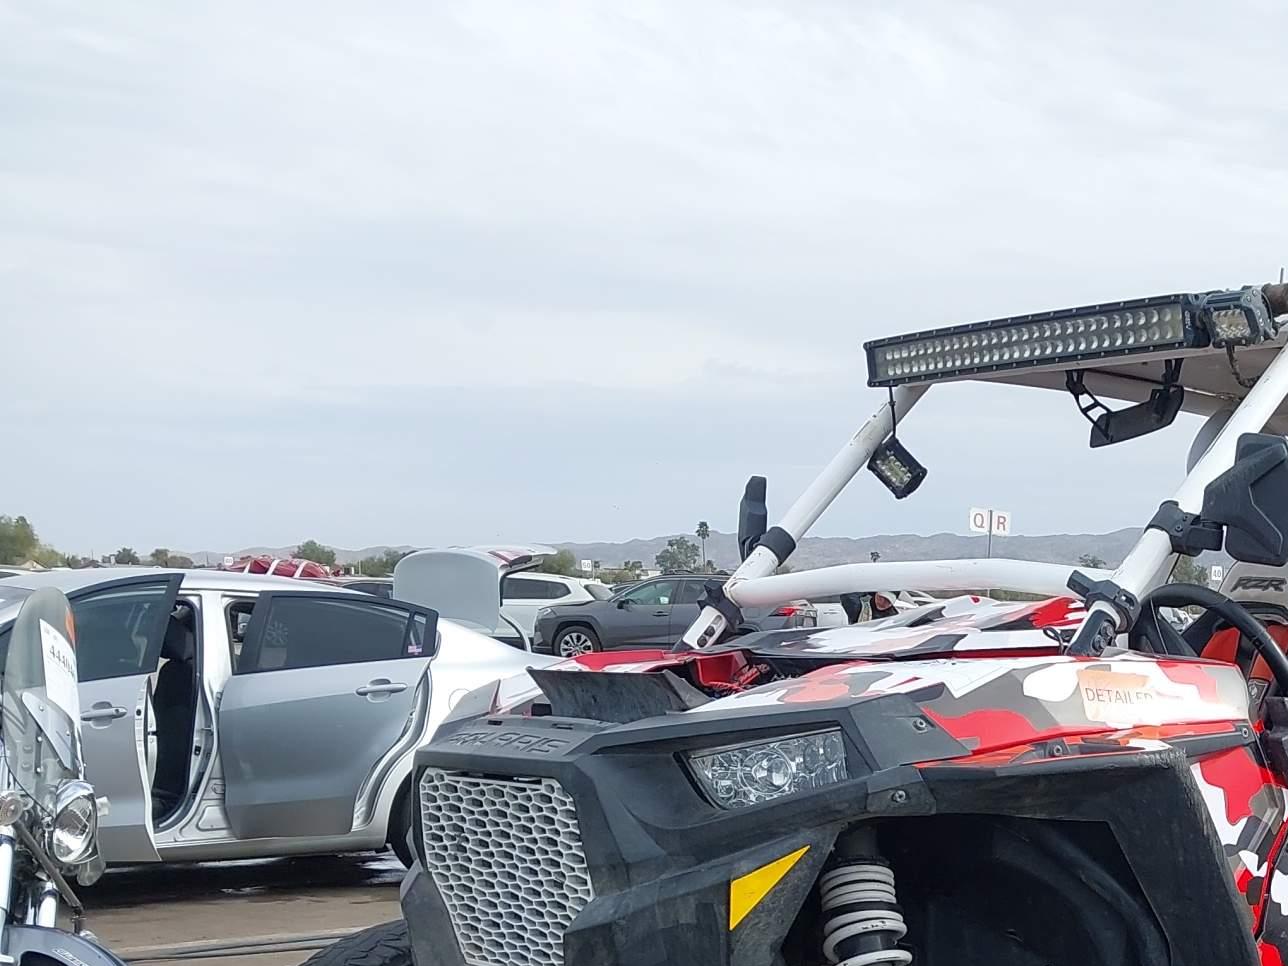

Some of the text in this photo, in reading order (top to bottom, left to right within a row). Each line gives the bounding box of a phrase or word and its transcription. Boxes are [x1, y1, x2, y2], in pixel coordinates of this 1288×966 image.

[973, 512, 985, 529] Q
[996, 515, 1007, 531] R
[1229, 575, 1287, 592] RZR
